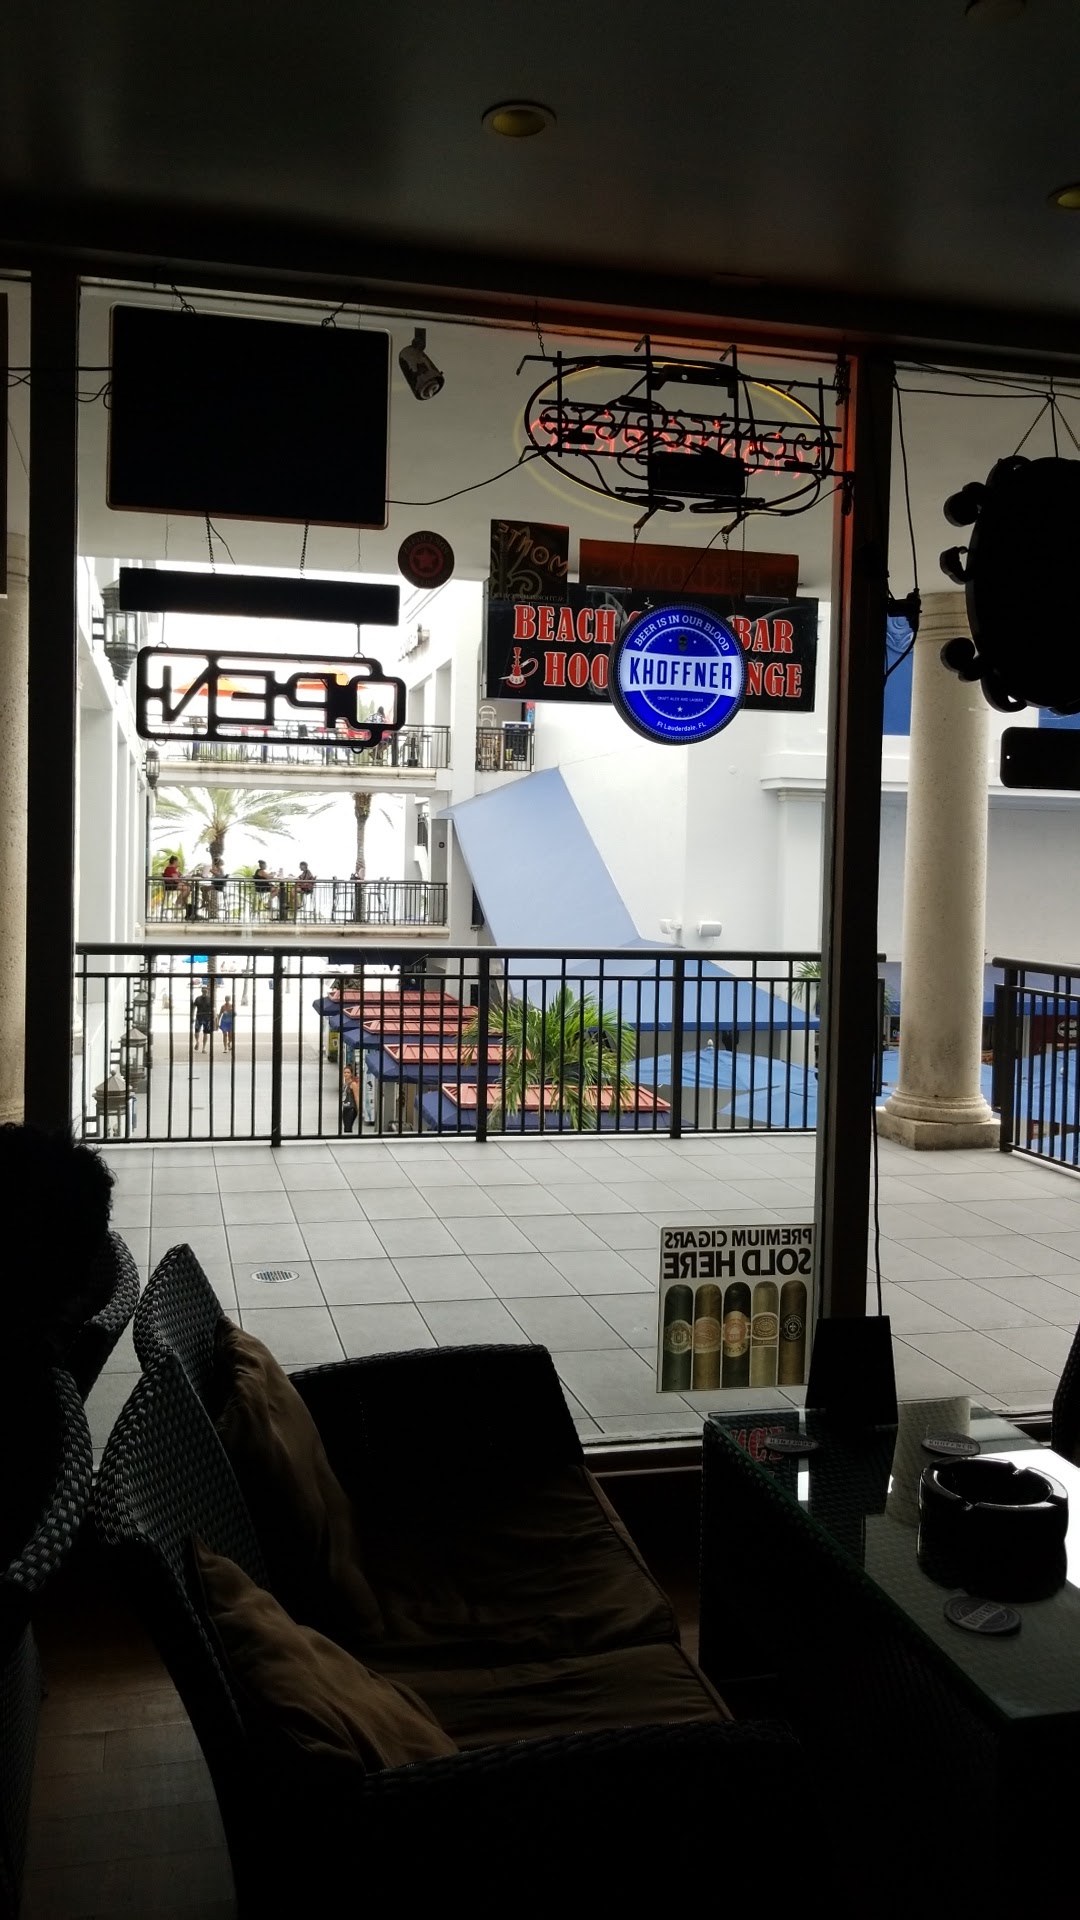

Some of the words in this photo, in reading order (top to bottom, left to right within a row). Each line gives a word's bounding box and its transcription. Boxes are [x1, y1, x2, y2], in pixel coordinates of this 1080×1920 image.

[513, 604, 618, 645] BEACH
[730, 616, 794, 654] BAR
[634, 623, 657, 648] BEER
[657, 617, 668, 629] IS
[668, 614, 680, 625] IN
[681, 614, 704, 628] OUR
[704, 622, 730, 651] BLOOD
[630, 657, 732, 690] KHOFFNER
[697, 721, 707, 729] FL
